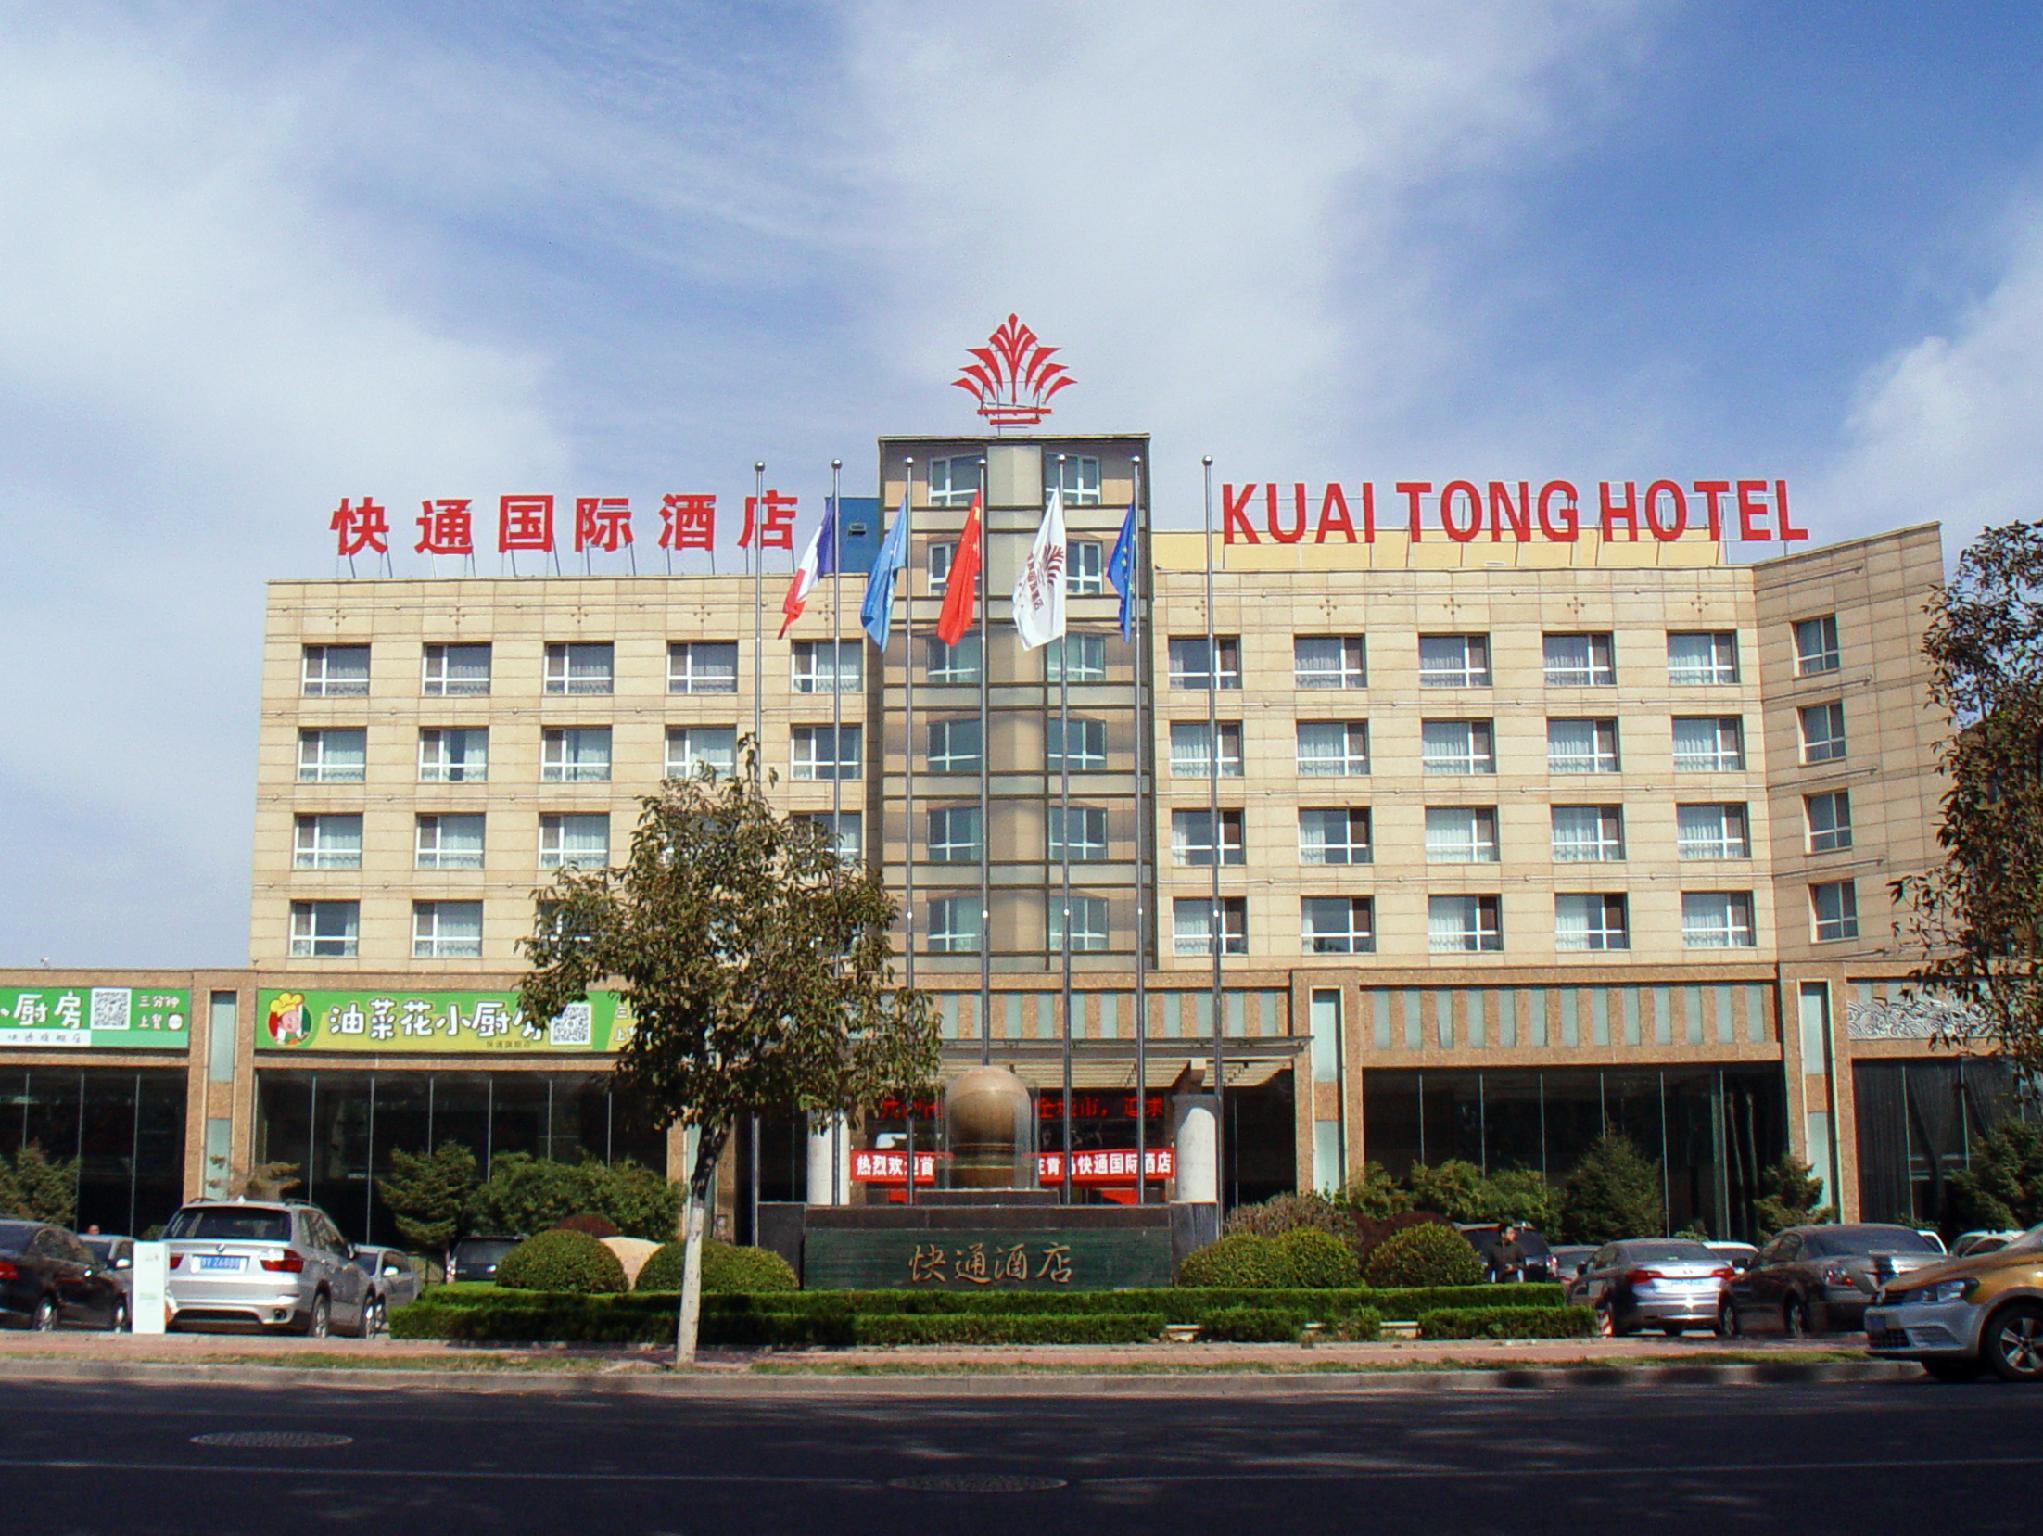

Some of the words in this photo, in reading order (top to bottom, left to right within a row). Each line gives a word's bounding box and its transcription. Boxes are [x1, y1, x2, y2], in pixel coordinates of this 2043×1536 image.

[329, 489, 798, 557] 快通国际酒店
[1223, 482, 1375, 544] KUAI
[1396, 480, 1579, 543] TONG
[1599, 480, 1809, 542] HOTEL
[0, 990, 82, 1030] 厨房
[907, 1241, 1073, 1285] 快通酒店
